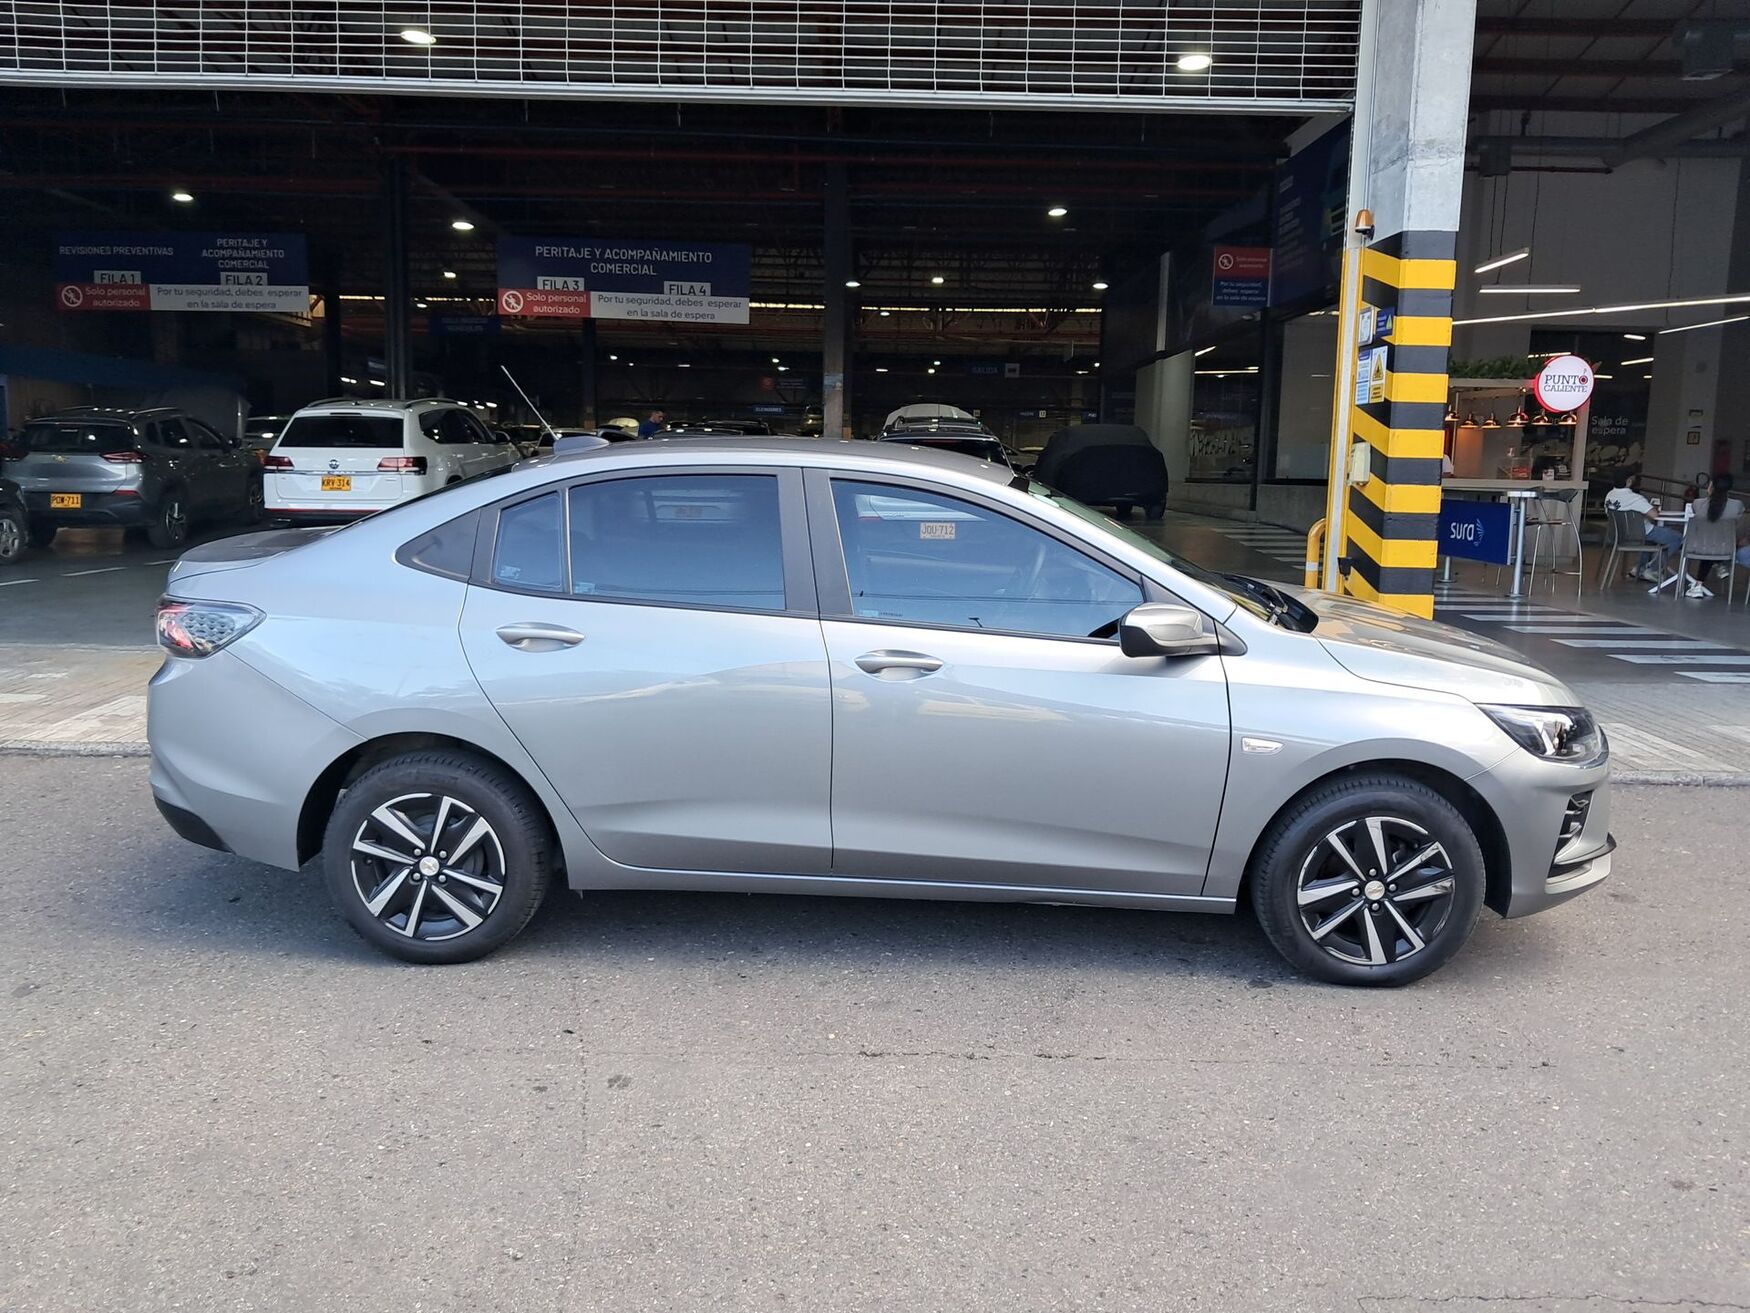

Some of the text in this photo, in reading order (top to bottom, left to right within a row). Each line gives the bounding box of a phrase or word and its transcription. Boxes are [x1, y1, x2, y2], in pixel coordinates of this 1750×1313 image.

[217, 238, 269, 247] PERITAJE Y
[113, 246, 174, 256] PREVENTIVAS
[201, 247, 285, 258] ACOMPAÑAMIENTO
[535, 246, 712, 263] PERITAJE Y ACOMPAÑAMIENTO
[218, 259, 270, 269] COMERCIAL
[590, 263, 657, 276] COMERCIAL
[100, 272, 136, 284] FILA 1
[225, 274, 263, 286] FILA 2
[542, 279, 580, 291] FILA 3
[669, 284, 707, 296] FILA 4
[157, 287, 172, 296] Por
[174, 288, 184, 296] tu
[526, 292, 587, 303] Solo personal
[597, 294, 742, 310] Por tu seguridad, debes esperar
[532, 305, 580, 314] autorizado
[640, 309, 649, 317] la
[650, 310, 669, 318] sala
[670, 311, 682, 319] de
[684, 312, 716, 321] espera
[1543, 373, 1588, 385] PUNTO
[1543, 384, 1588, 393] CALIENTE
[1591, 415, 1613, 427] Sala
[1615, 416, 1629, 426] de
[1591, 426, 1626, 437] espera
[1449, 521, 1475, 542] sura
